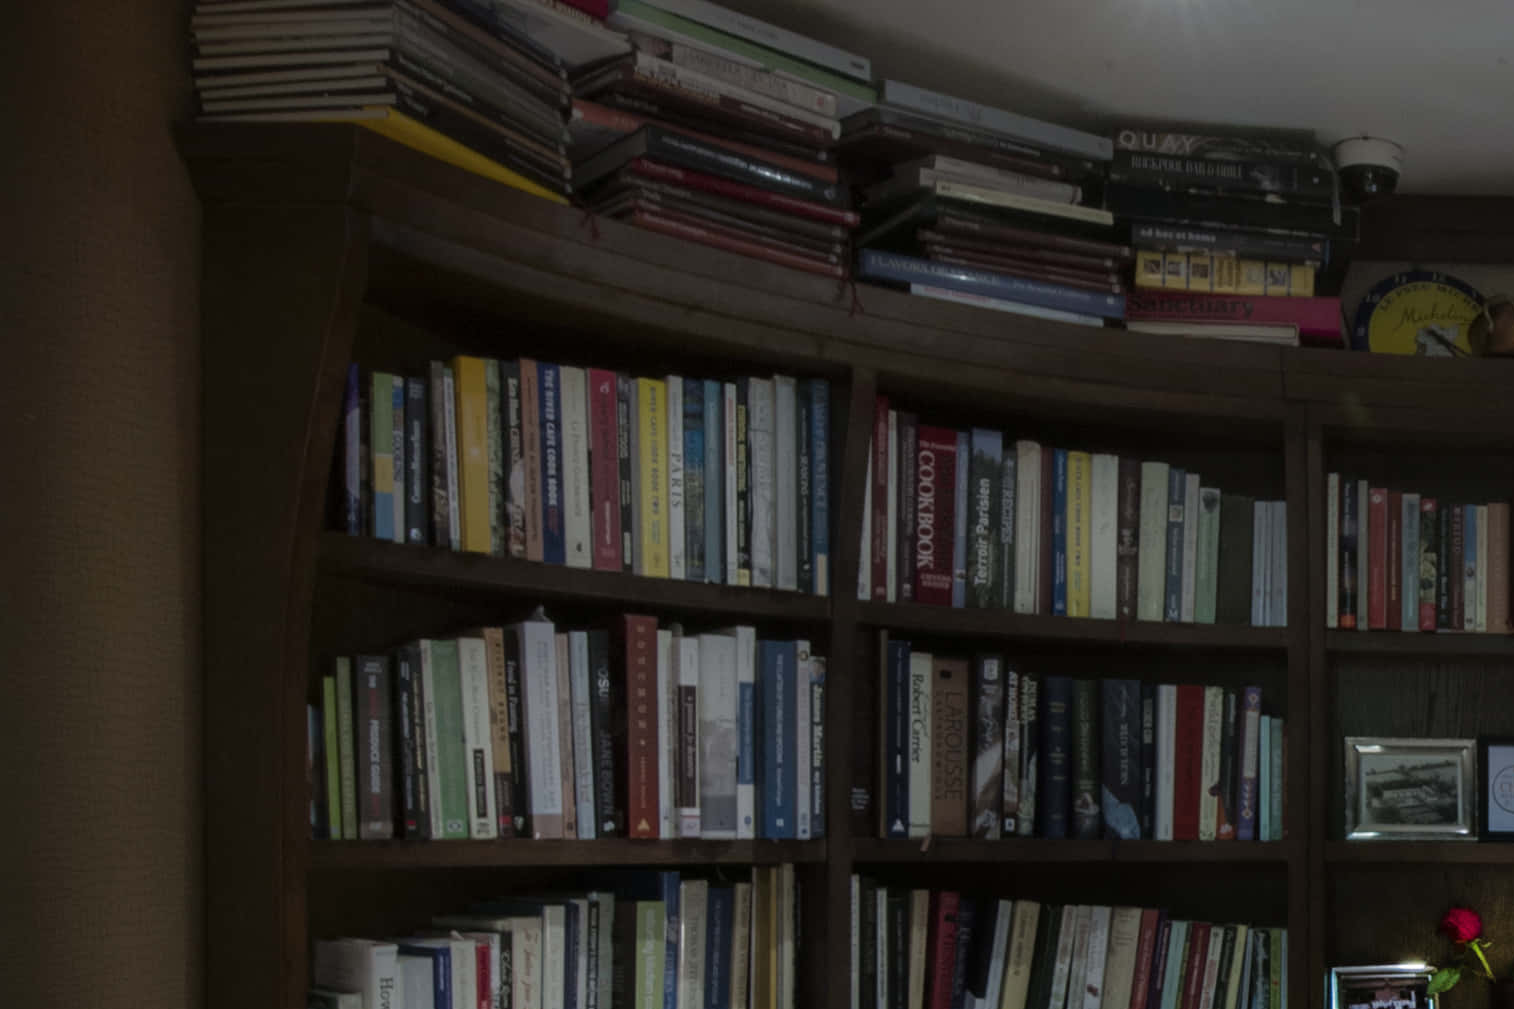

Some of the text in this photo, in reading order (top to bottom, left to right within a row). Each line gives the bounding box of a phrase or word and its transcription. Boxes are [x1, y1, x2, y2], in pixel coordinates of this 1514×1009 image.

[1119, 130, 1197, 153] QUAY
[1127, 294, 1254, 317] Sanctuary
[671, 453, 683, 508] PARIS
[916, 450, 937, 570] COOKBOOK
[974, 477, 991, 585] Terroir Parisien
[812, 684, 823, 723] James
[911, 673, 926, 764] Robert Carrier
[812, 724, 823, 767] Martin
[944, 692, 963, 800] LAROUSSE
[600, 769, 614, 815] BOWN
